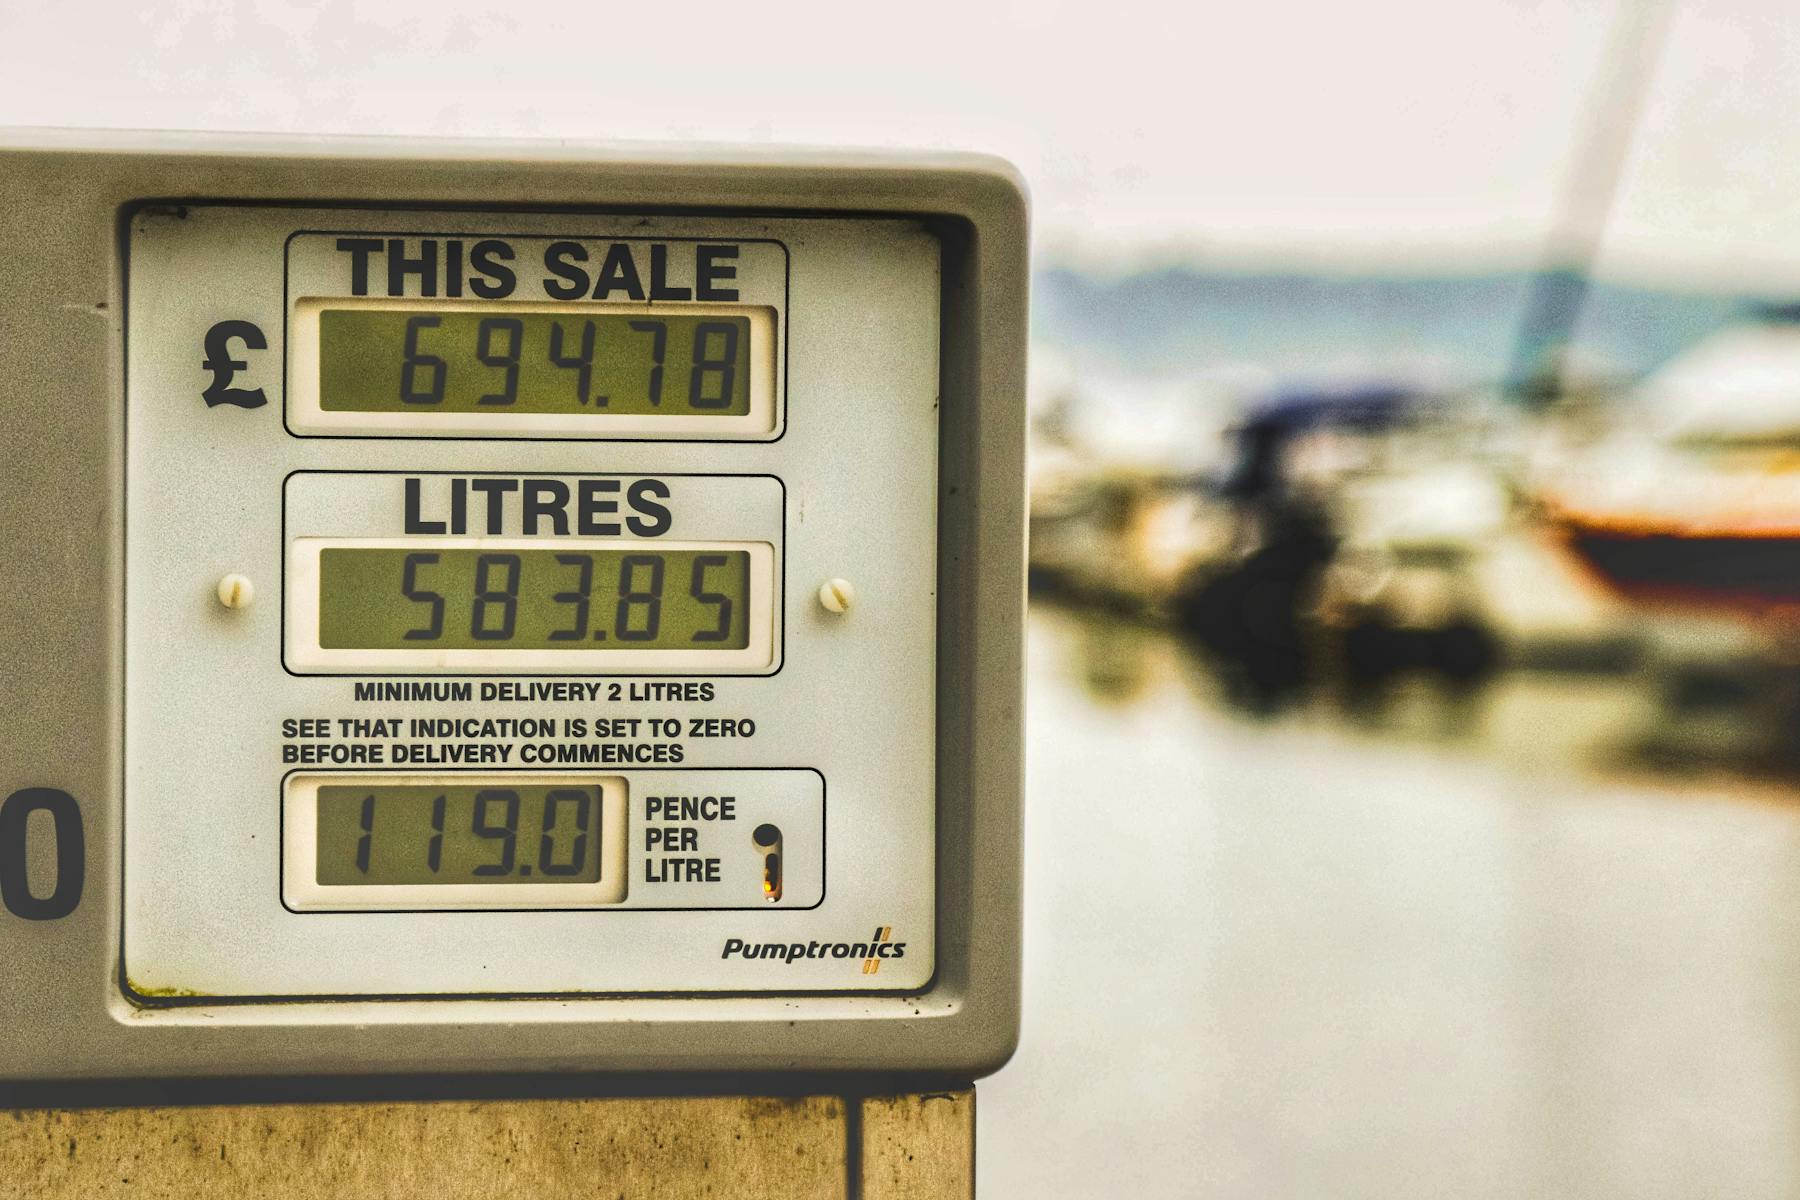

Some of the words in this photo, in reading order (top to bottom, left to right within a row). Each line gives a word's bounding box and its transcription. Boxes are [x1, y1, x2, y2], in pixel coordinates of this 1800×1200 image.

[337, 239, 517, 299] THIS
[543, 243, 739, 301] SALE
[202, 320, 268, 409] £
[399, 316, 739, 409] 694.78
[405, 479, 671, 537] LITRES
[403, 554, 732, 641] 583.85
[355, 683, 471, 701] MINIMUM
[481, 683, 600, 701] DELIVERY
[608, 683, 621, 701] 2
[630, 683, 714, 701] LITRES
[283, 719, 330, 738] SEE
[338, 719, 403, 737] THAT
[411, 719, 555, 738] INDICATION
[565, 719, 587, 737] IS
[595, 719, 641, 737] SET
[648, 719, 681, 737] TO
[689, 719, 755, 737] ZERO
[283, 745, 383, 763] BEFORE
[392, 745, 512, 763] DELIVERY
[520, 744, 683, 763] COMMENCES
[646, 797, 735, 820] PENCE
[356, 790, 590, 876] 119.0
[646, 828, 697, 851] PER
[646, 859, 720, 882] LITRE
[722, 927, 906, 964] Pumptronics
